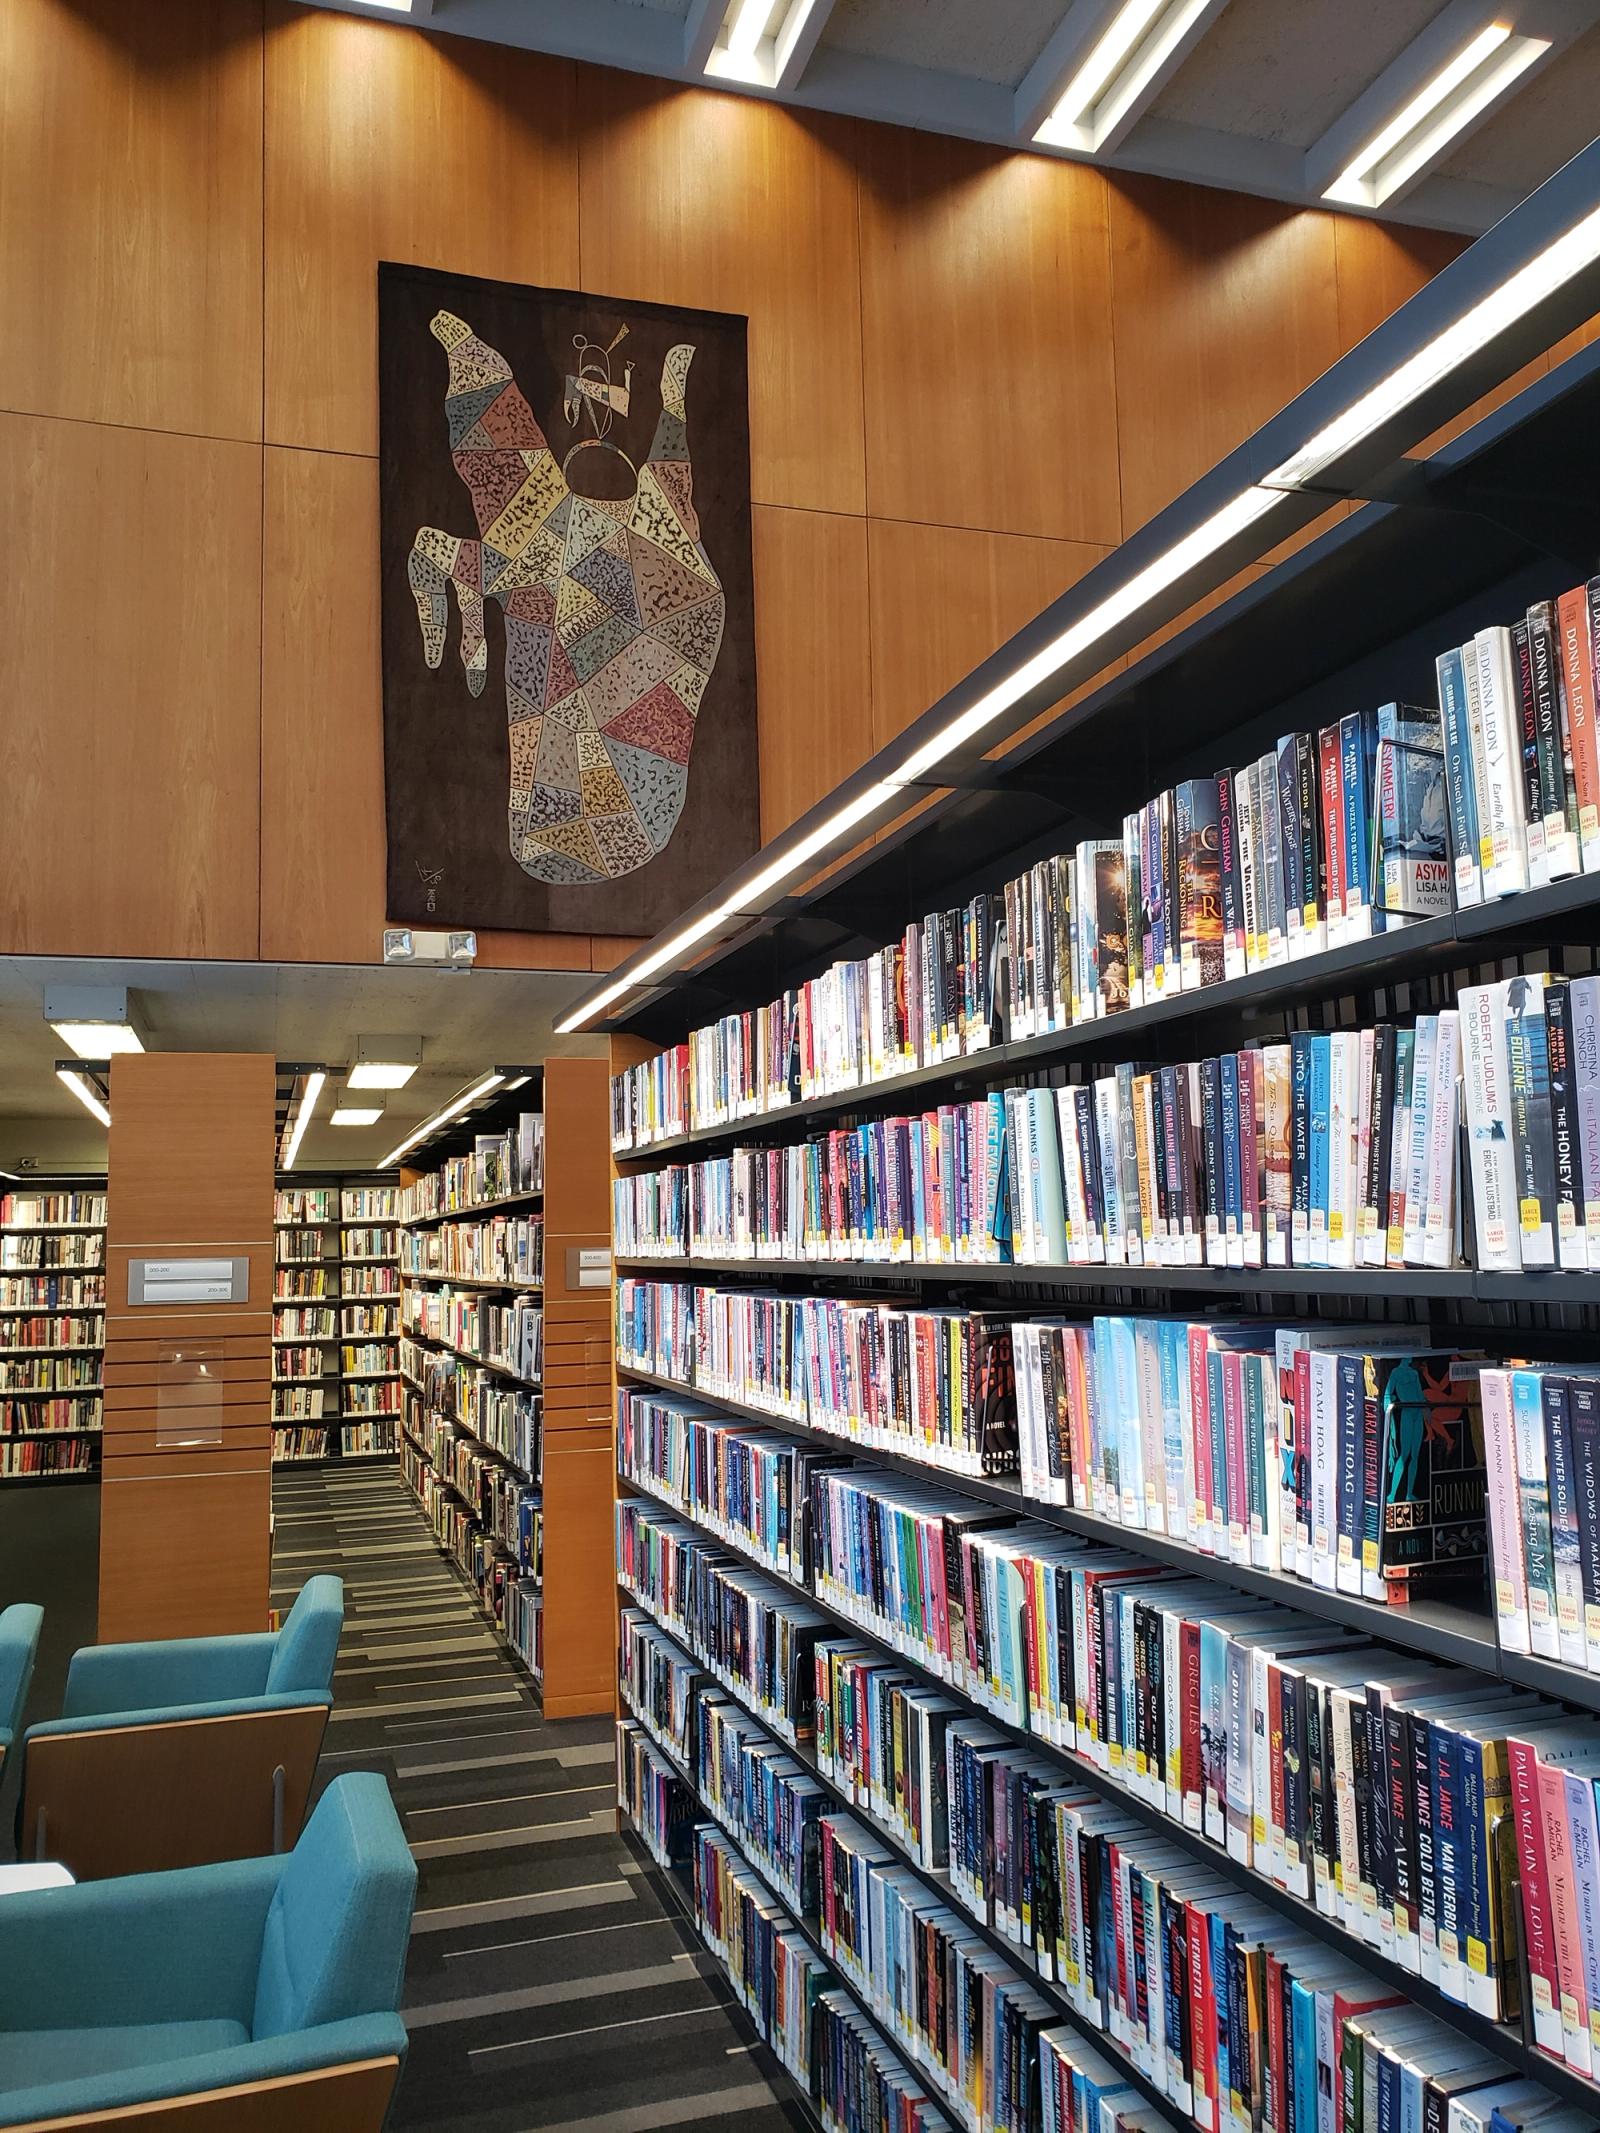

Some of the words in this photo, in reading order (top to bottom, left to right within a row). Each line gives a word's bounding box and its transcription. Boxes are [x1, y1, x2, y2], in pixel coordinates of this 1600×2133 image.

[1519, 649, 1531, 698] DONNA
[1534, 637, 1549, 689] DONNA
[1566, 628, 1580, 681] DONNA
[1481, 657, 1494, 708] DONNA
[1523, 702, 1536, 741] LEON
[1538, 693, 1553, 732] LEON
[1572, 686, 1585, 728] LEON
[1485, 714, 1498, 752] LEON
[1329, 758, 1338, 801] PARNELL
[1349, 744, 1358, 788] PARNELL
[1546, 751, 1557, 794] Temptation
[1217, 777, 1229, 812] JOHN
[1454, 776, 1464, 803] Such
[1530, 779, 1540, 809] Falling
[1176, 798, 1186, 844] GRISHAM
[1183, 805, 1192, 832] JOHN
[1151, 835, 1160, 881] GRISHAM
[1220, 816, 1232, 873] GRISHAM
[1330, 824, 1338, 876] PURLOINED
[1415, 863, 1448, 881] ASYM
[1416, 882, 1438, 893] LISA
[1178, 859, 1188, 929] RECKONING
[1424, 897, 1449, 906] NOVEL
[1468, 1012, 1481, 1061] BOURNE
[1478, 994, 1492, 1051] ROBERT
[1511, 1019, 1521, 1034] THE
[1549, 1025, 1559, 1054] ALIDA
[1295, 1050, 1304, 1082] INTO
[1510, 1036, 1525, 1093] BOURNE
[1524, 1037, 1533, 1061] ROBERT
[1557, 1028, 1567, 1069] HARRIET
[1576, 1028, 1588, 1070] LYNCH
[1584, 1014, 1599, 1081] CHRISTINA
[1297, 1085, 1305, 1110] THE
[1397, 1065, 1405, 1095] ERNEST
[1414, 1071, 1428, 1110] TRACES
[1472, 1064, 1484, 1115] IMPERATIVE
[1483, 1055, 1498, 1113] LUDLUM'S
[988, 1101, 999, 1143] JANET
[1028, 1095, 1036, 1118] TOM
[1413, 1114, 1425, 1127] OF
[1517, 1096, 1527, 1137] INITIATIVE
[1557, 1107, 1567, 1128] THE
[887, 1131, 896, 1155] JANET
[1029, 1120, 1038, 1153] HANKS
[1080, 1124, 1089, 1151] SOPHIE
[1165, 1105, 1175, 1154] CHARLAINE
[1297, 1116, 1306, 1161] WATER
[1411, 1130, 1425, 1160] GUILT
[1587, 1118, 1600, 1175] ITALIAN
[888, 1157, 898, 1202] EVANOVICH
[1084, 1152, 1092, 1184] HANNAH
[1168, 1155, 1177, 1188] HARRIS
[1483, 1150, 1492, 1168] ERIC
[1485, 1169, 1494, 1184] VAN
[1524, 1154, 1534, 1171] ERIC
[1558, 1130, 1572, 1190] HONEY
[1104, 1165, 1113, 1196] SOPHIE
[1140, 1177, 1148, 1219] HARPER
[1107, 1200, 1118, 1236] HANNAH
[1485, 1185, 1496, 1220] LUSTBAD
[1193, 1340, 1202, 1377] Winter
[1144, 1358, 1153, 1418] Hilderbrand
[1208, 1364, 1216, 1408] WINTER
[1226, 1367, 1234, 1411] WINTER
[1316, 1379, 1324, 1420] TAMI
[1194, 1395, 1204, 1448] Paradise
[1344, 1389, 1355, 1435] TAMI
[1364, 1404, 1378, 1434] CARA
[1491, 1412, 1500, 1442] SUSAN
[1552, 1415, 1561, 1436] THE
[1249, 1418, 1257, 1461] STROLL
[1316, 1426, 1325, 1469] HOAG
[1495, 1444, 1503, 1474] MANN
[1554, 1438, 1565, 1481] WINTER
[1583, 1441, 1591, 1457] THE
[1345, 1442, 1356, 1494] HOAG
[1364, 1439, 1378, 1497] HOFFMAN
[1557, 1485, 1568, 1532] SOLDIER
[1584, 1462, 1596, 1520] WIDOWS
[1526, 1496, 1542, 1546] Losing
[946, 1541, 955, 1592] FOLLETT
[1531, 1552, 1546, 1578] Me
[974, 1590, 982, 1631] FORSYTH
[1188, 1654, 1198, 1701] GREG
[1137, 1688, 1146, 1716] INTO
[1189, 1704, 1200, 1735] ILES
[856, 1727, 864, 1772] EVOLUTION
[1232, 1713, 1240, 1767] IRVING
[1373, 1716, 1384, 1753] Death
[1022, 1796, 1030, 1821] LISA
[1341, 1796, 1352, 1815] Six
[1391, 1776, 1405, 1820] JANCE
[1417, 1780, 1431, 1829] JANCE
[1439, 1785, 1453, 1830] JANCE
[1314, 1802, 1323, 1842] Fixing
[1343, 1818, 1354, 1846] Cats
[1361, 1805, 1370, 1839] Twelve
[1546, 1810, 1557, 1862] McMILLAN
[1553, 1819, 1564, 1857] RACHEL
[1419, 1832, 1433, 1876] COLD
[1441, 1841, 1455, 1874] MAN
[1515, 1750, 1529, 1803] PAULA
[1530, 1904, 1545, 1953] LOVE
[1572, 1817, 1584, 1869] McMILLAN
[1580, 1825, 1591, 1864] RACHEL
[1066, 1865, 1078, 1936] JOHANSEN
[1145, 1901, 1154, 1945] NIGHT
[1191, 1936, 1202, 1999] VENDETTA
[1194, 2006, 1203, 2034] IRIS
[1285, 2003, 1294, 2040] STEPHEN
[1344, 2065, 1355, 2097] DAVID
[1288, 2100, 1297, 2122] LIVES
[1345, 2098, 1355, 2120] JOY
